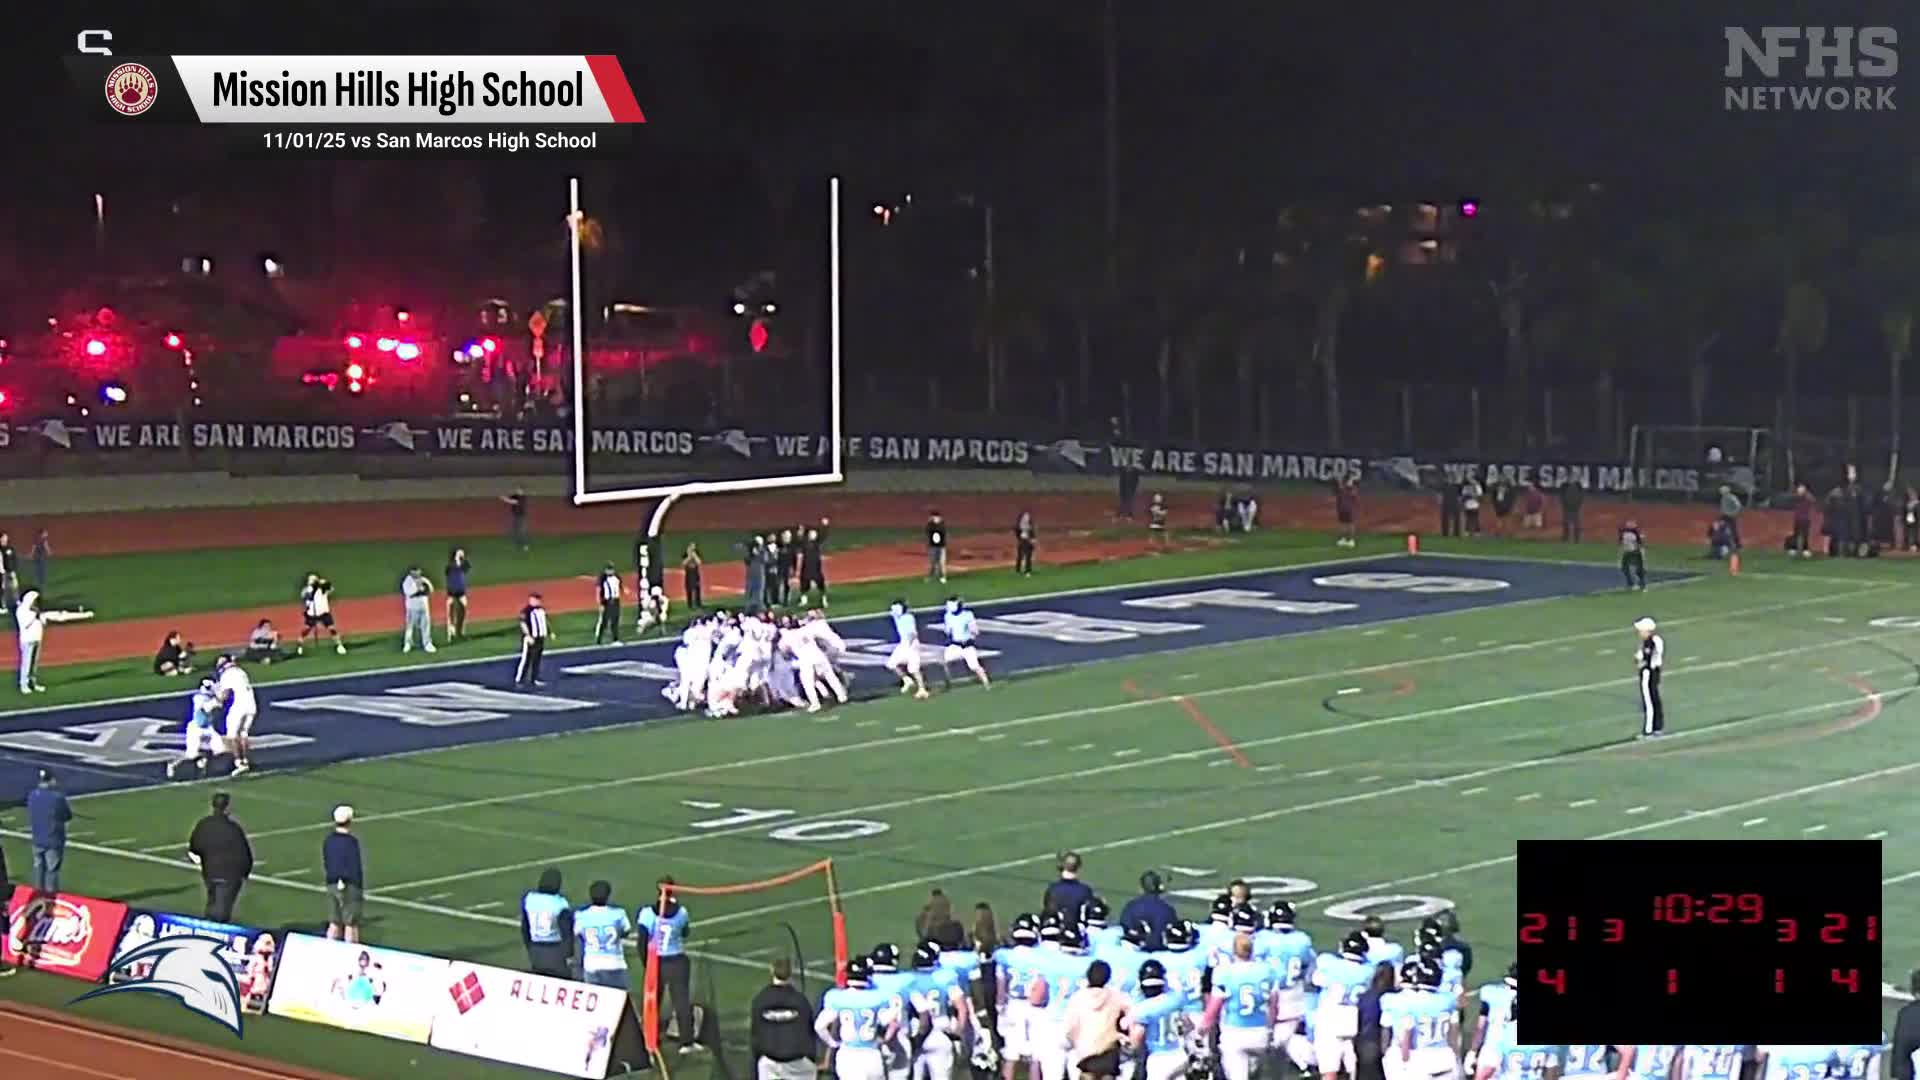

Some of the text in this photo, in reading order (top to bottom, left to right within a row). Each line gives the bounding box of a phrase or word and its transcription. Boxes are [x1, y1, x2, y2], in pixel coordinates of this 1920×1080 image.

[95, 424, 132, 447] WE
[192, 423, 244, 447] SAN
[252, 425, 356, 449] MARCOS
[437, 428, 473, 449] WE
[480, 428, 525, 450] ARE
[592, 430, 693, 454] MARCOS
[775, 435, 810, 457] WE
[869, 436, 920, 460] SAN
[927, 439, 1030, 464] MARCOS
[1109, 446, 1363, 481] WE ARE SAN MARCOS
[510, 979, 599, 1013] ALLRED
